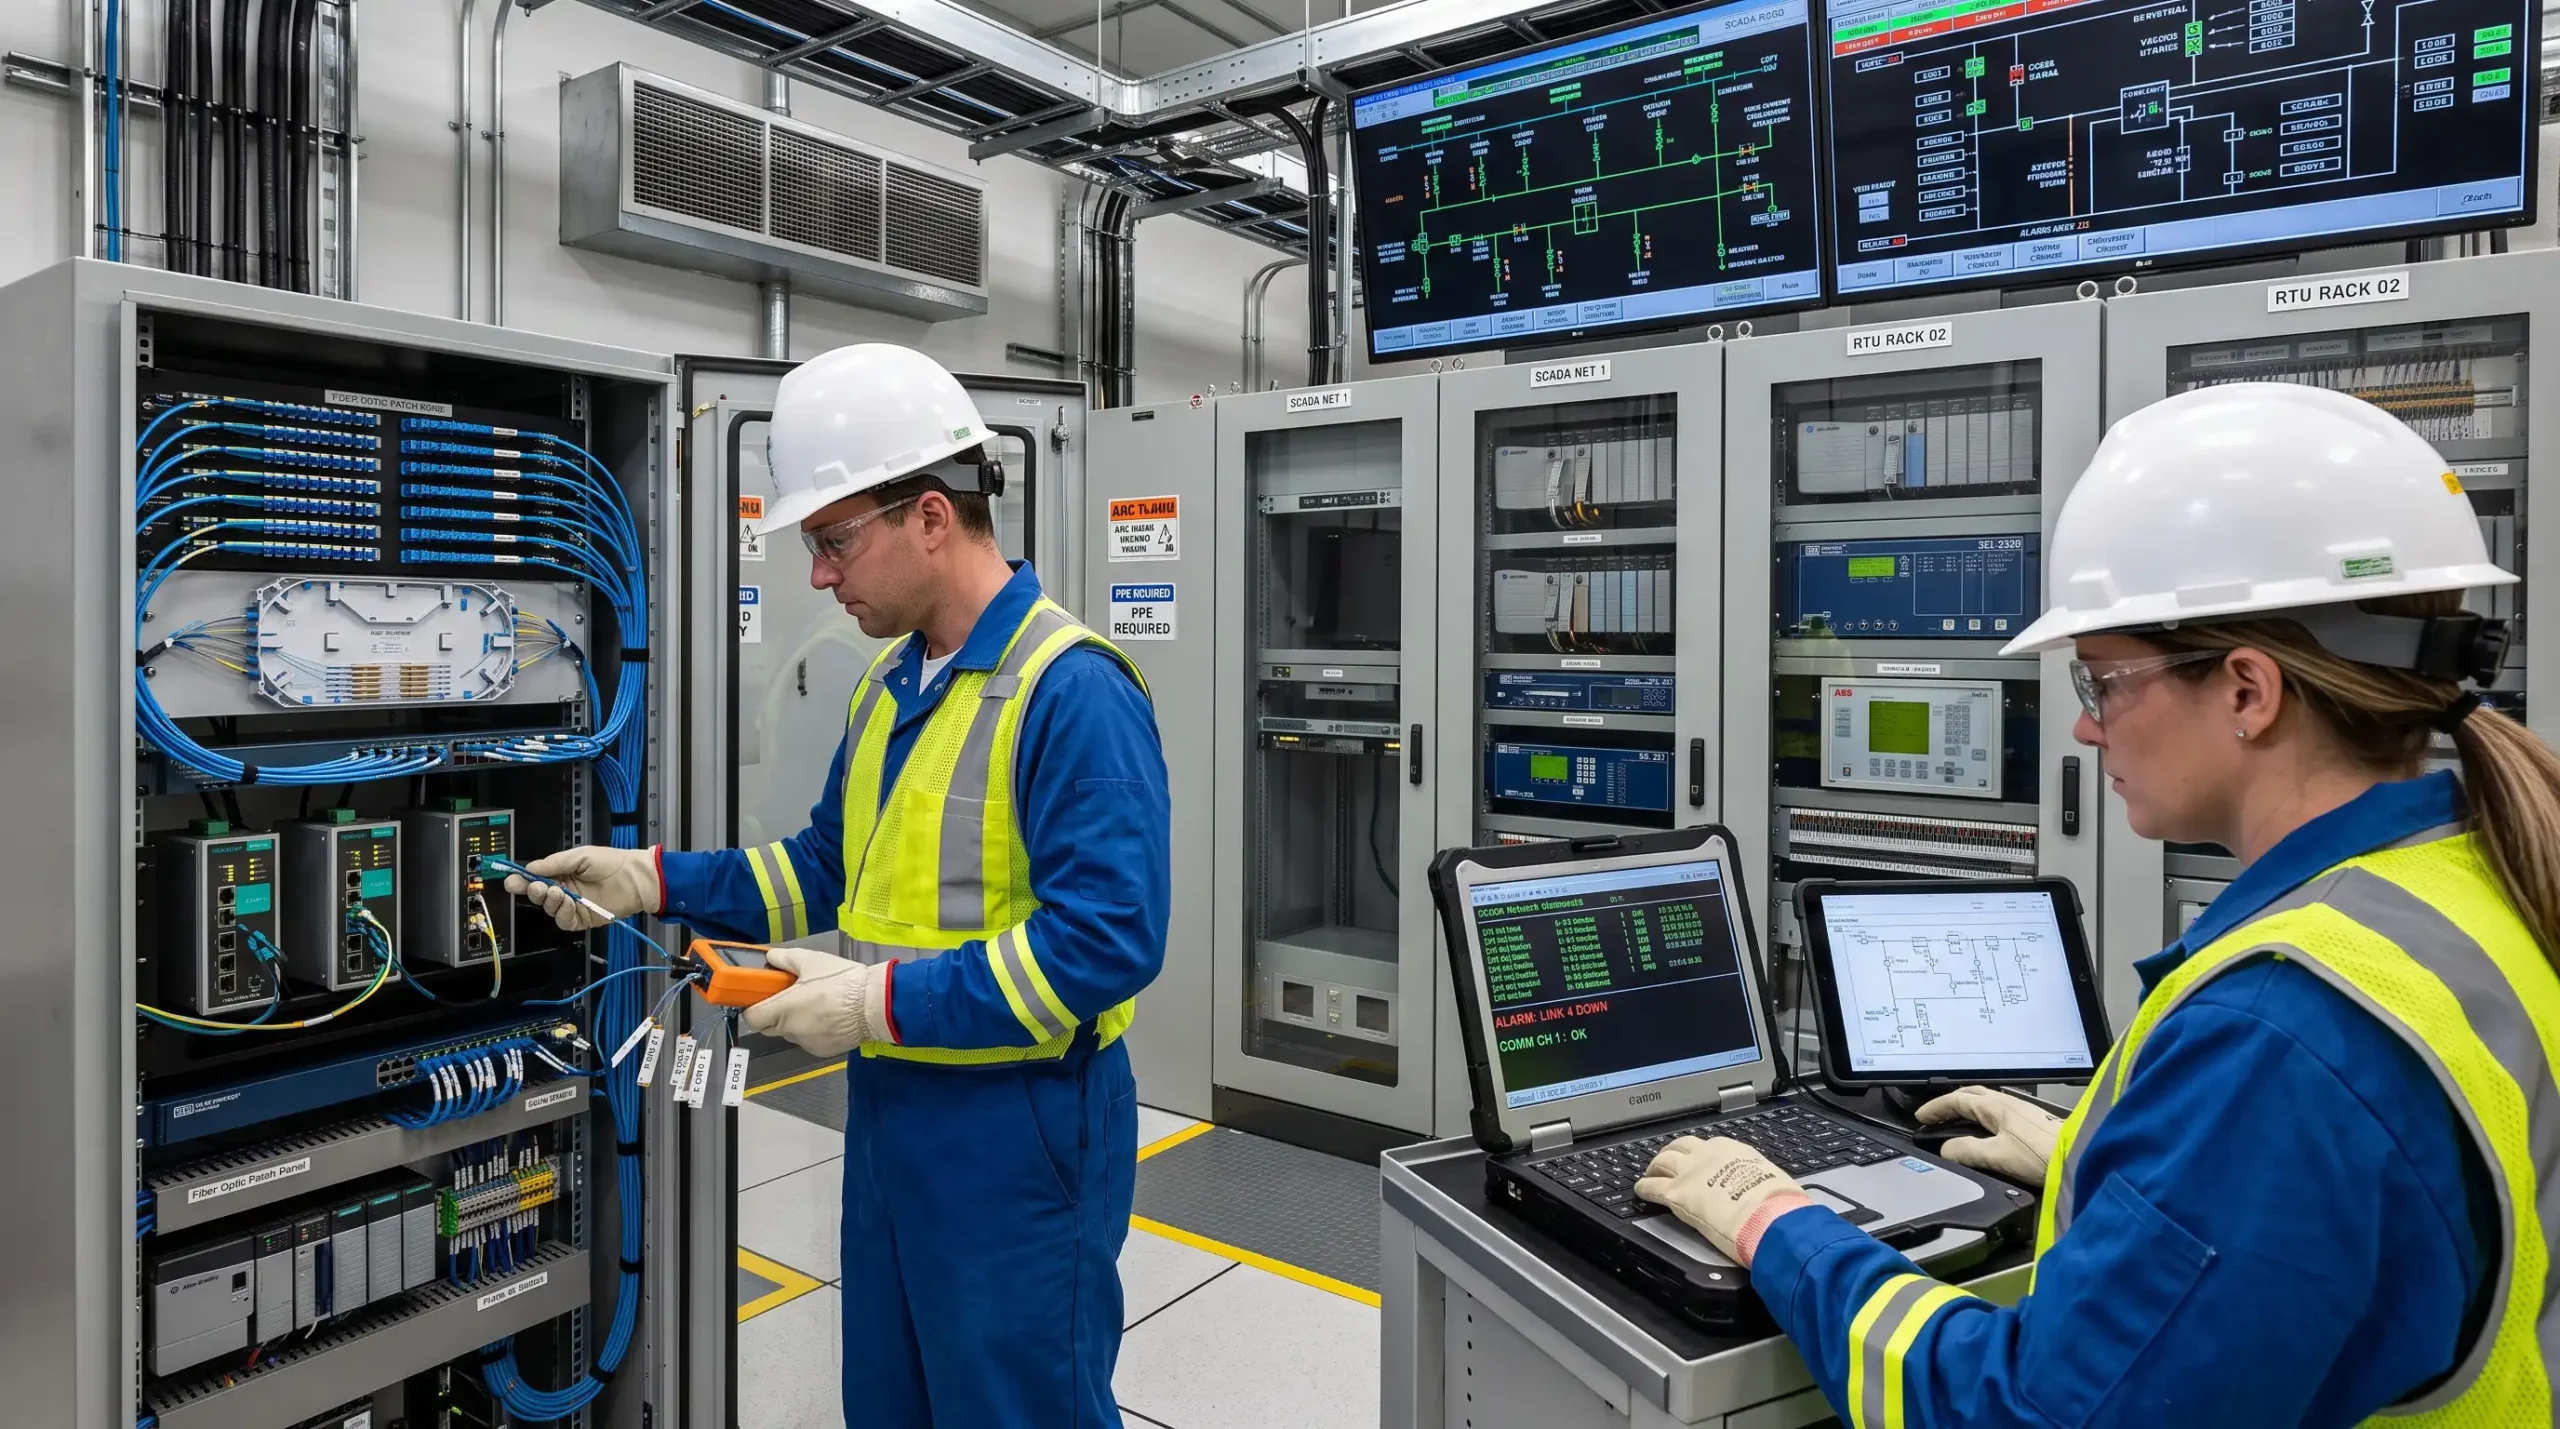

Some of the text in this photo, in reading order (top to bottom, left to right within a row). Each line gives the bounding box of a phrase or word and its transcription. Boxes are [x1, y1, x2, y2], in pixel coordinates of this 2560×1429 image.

[1725, 14, 1756, 30] SCADA
[2275, 278, 2400, 305] RTU RACK 02
[1853, 328, 1947, 350] RTU RACK 02
[1535, 364, 1605, 383] SCADA NET 1
[390, 399, 418, 410] PATCH
[1290, 395, 1320, 408] SCADA
[1322, 393, 1340, 405] NET
[1115, 588, 1132, 599] PPE
[1131, 607, 1154, 619] PPE
[1114, 622, 1171, 636] REQUIRED
[1495, 1000, 1609, 1029] ALARM: LINK 4 DOWN
[1499, 1034, 1535, 1053] COMM
[1536, 1031, 1553, 1047] CH
[1570, 1028, 1588, 1042] OK
[192, 1186, 218, 1200] Fiber
[220, 1177, 247, 1192] Optic
[279, 1160, 306, 1176] Panel
